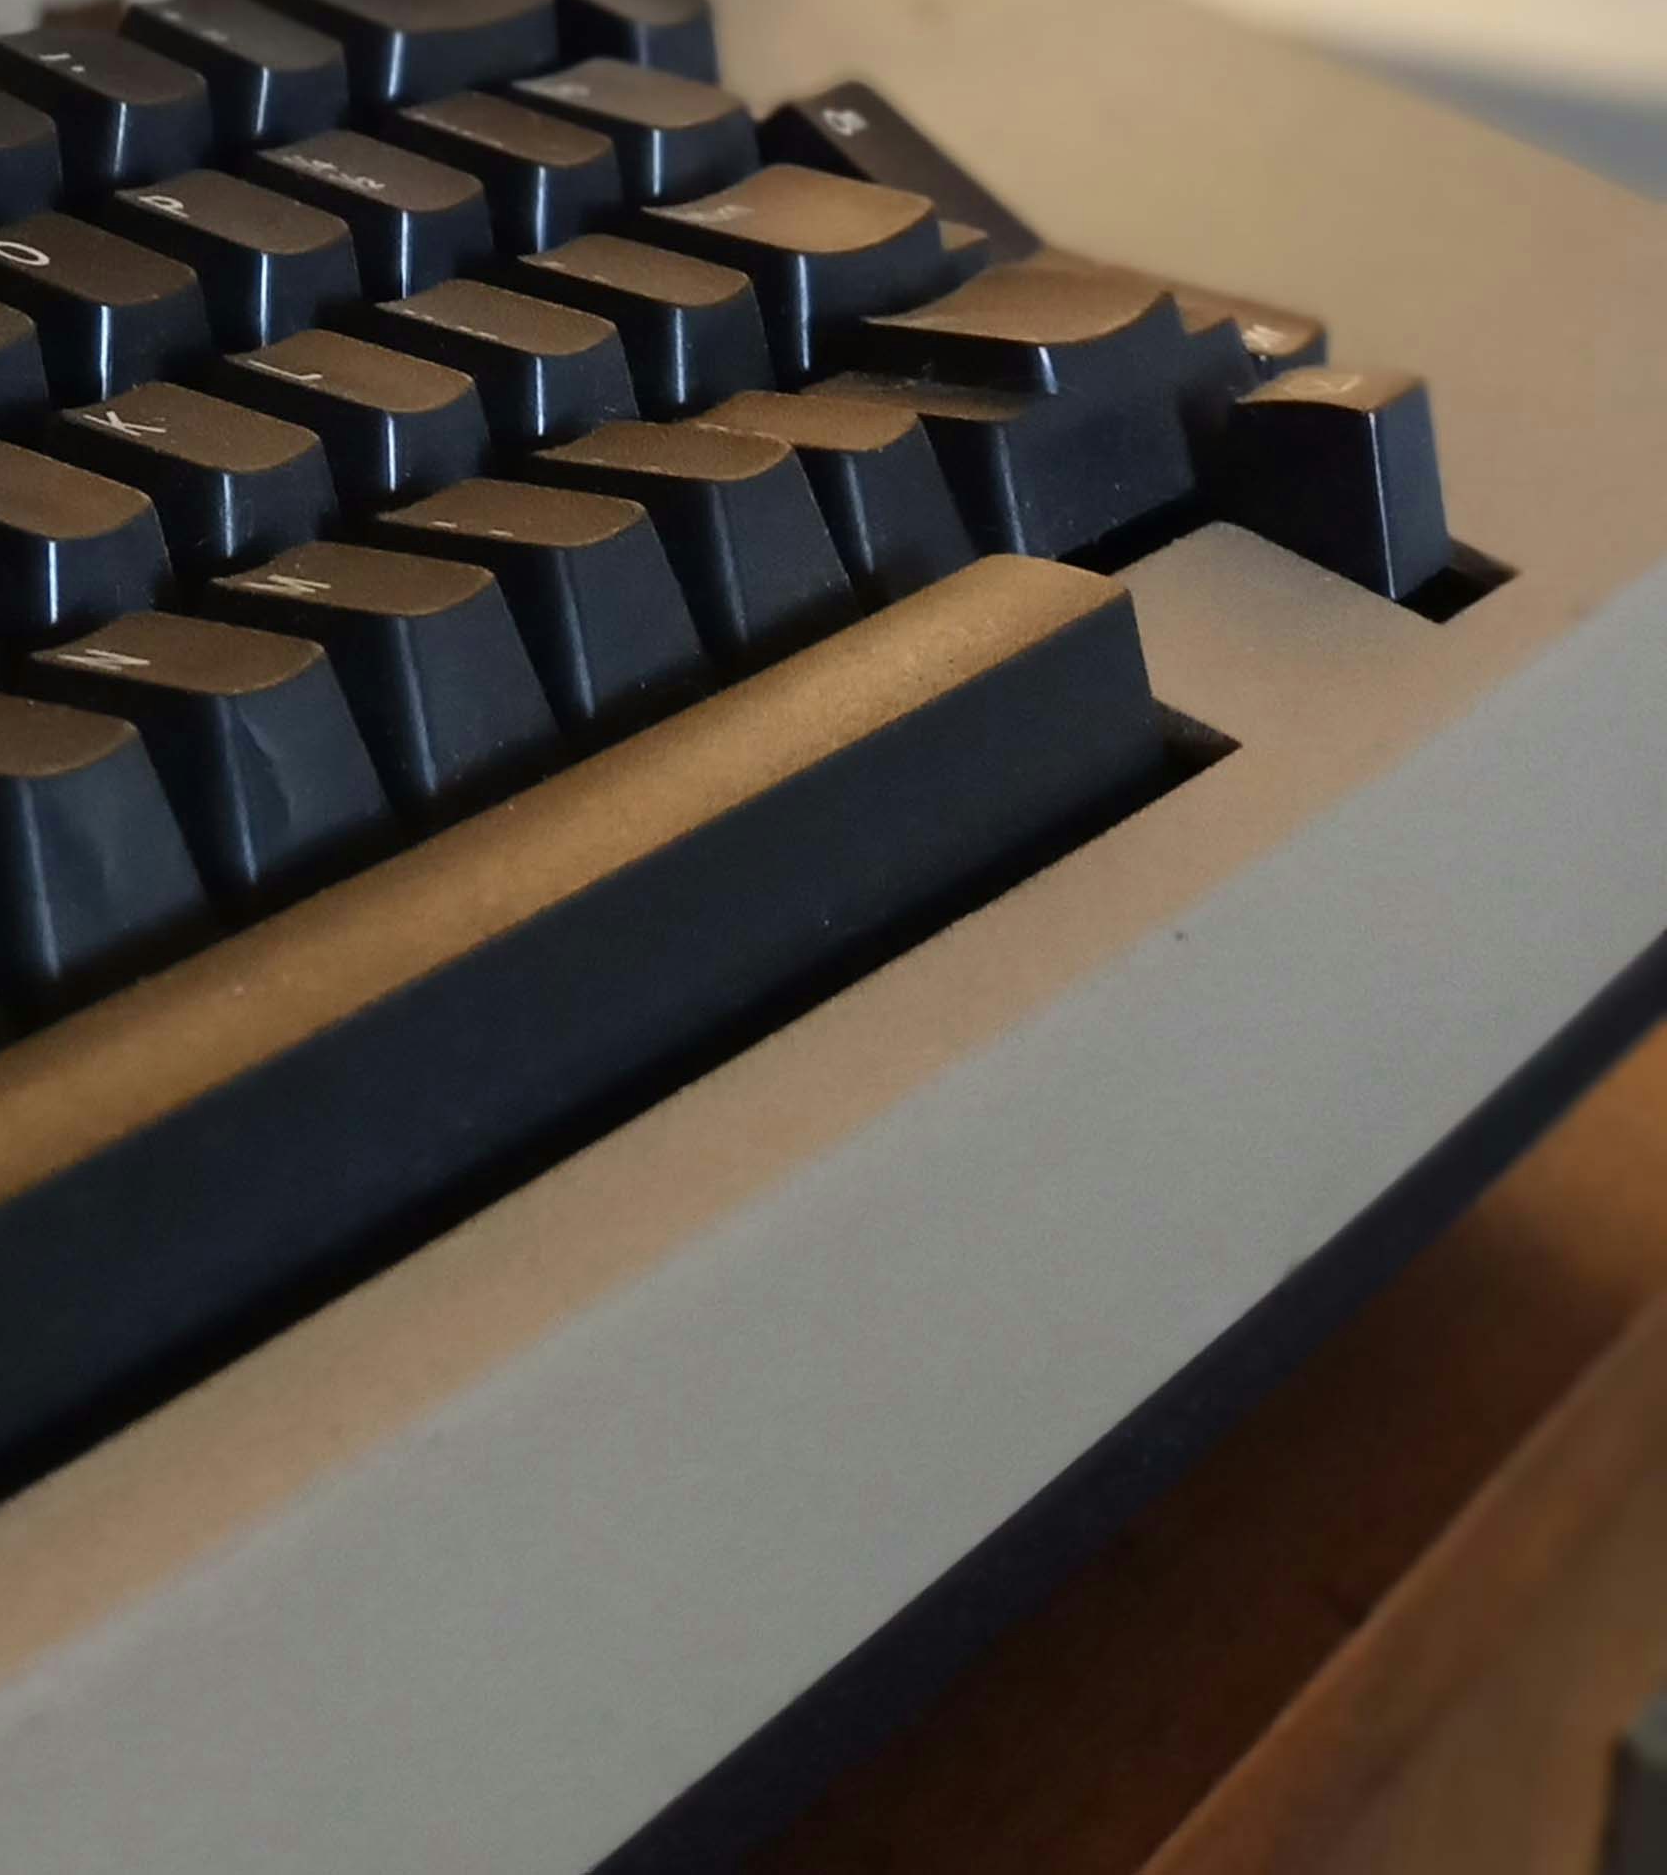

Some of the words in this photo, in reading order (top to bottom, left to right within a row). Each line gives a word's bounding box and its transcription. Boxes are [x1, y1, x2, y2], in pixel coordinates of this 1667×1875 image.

[138, 195, 189, 218] P
[248, 360, 323, 382] L
[84, 410, 167, 437] K
[243, 574, 331, 595] M
[59, 648, 150, 671] N
